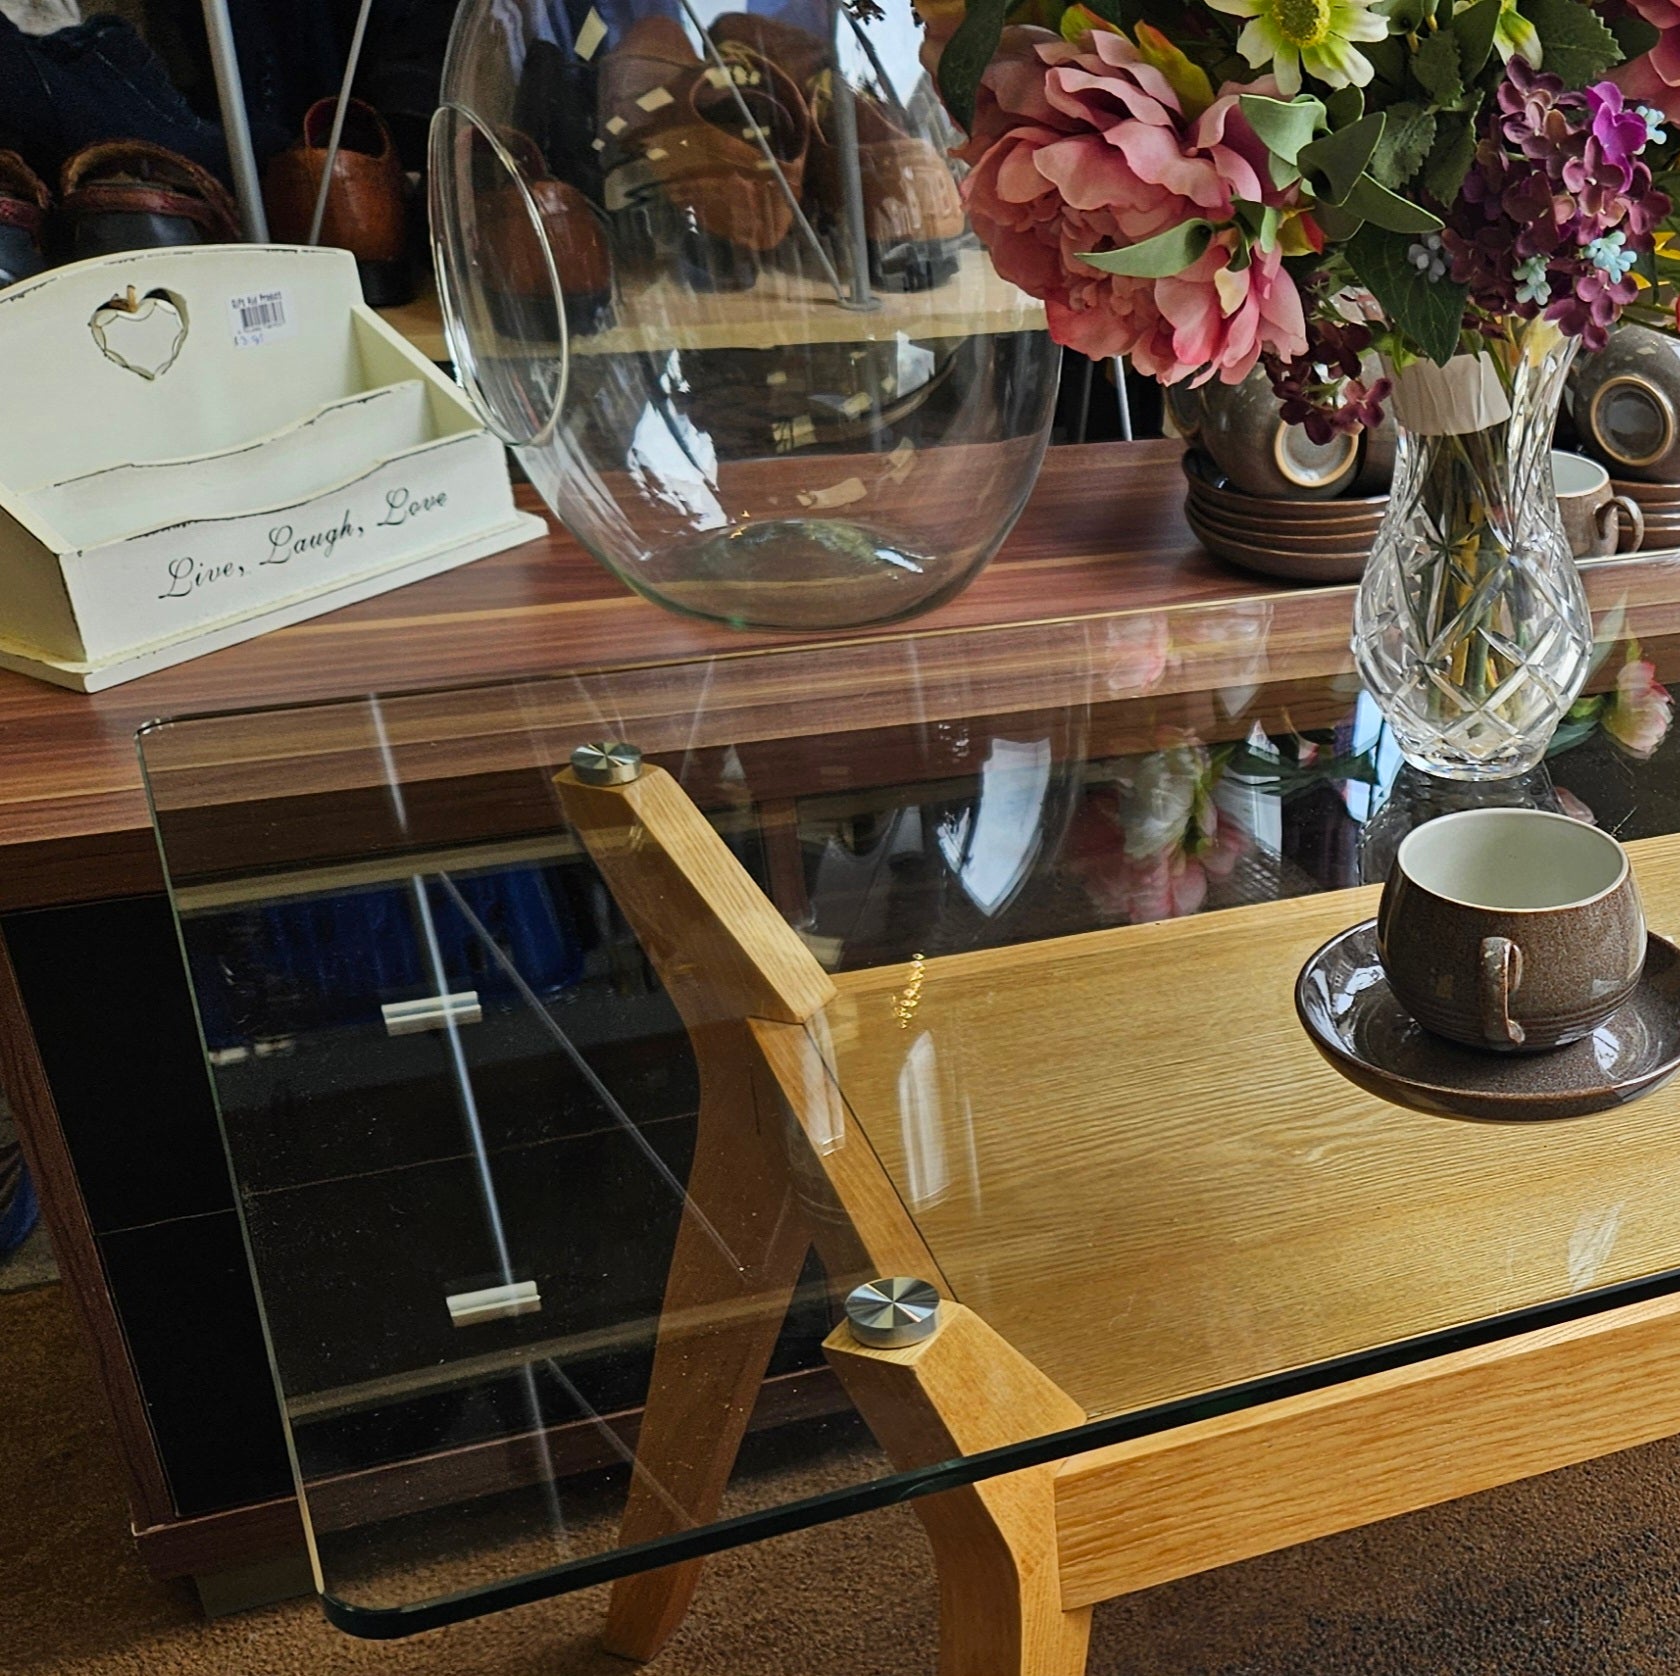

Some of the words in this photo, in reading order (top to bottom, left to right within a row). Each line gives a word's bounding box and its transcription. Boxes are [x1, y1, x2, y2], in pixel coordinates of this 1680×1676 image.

[158, 556, 245, 599] Live,
[259, 508, 364, 566] Laugh,
[377, 487, 448, 527] Love
